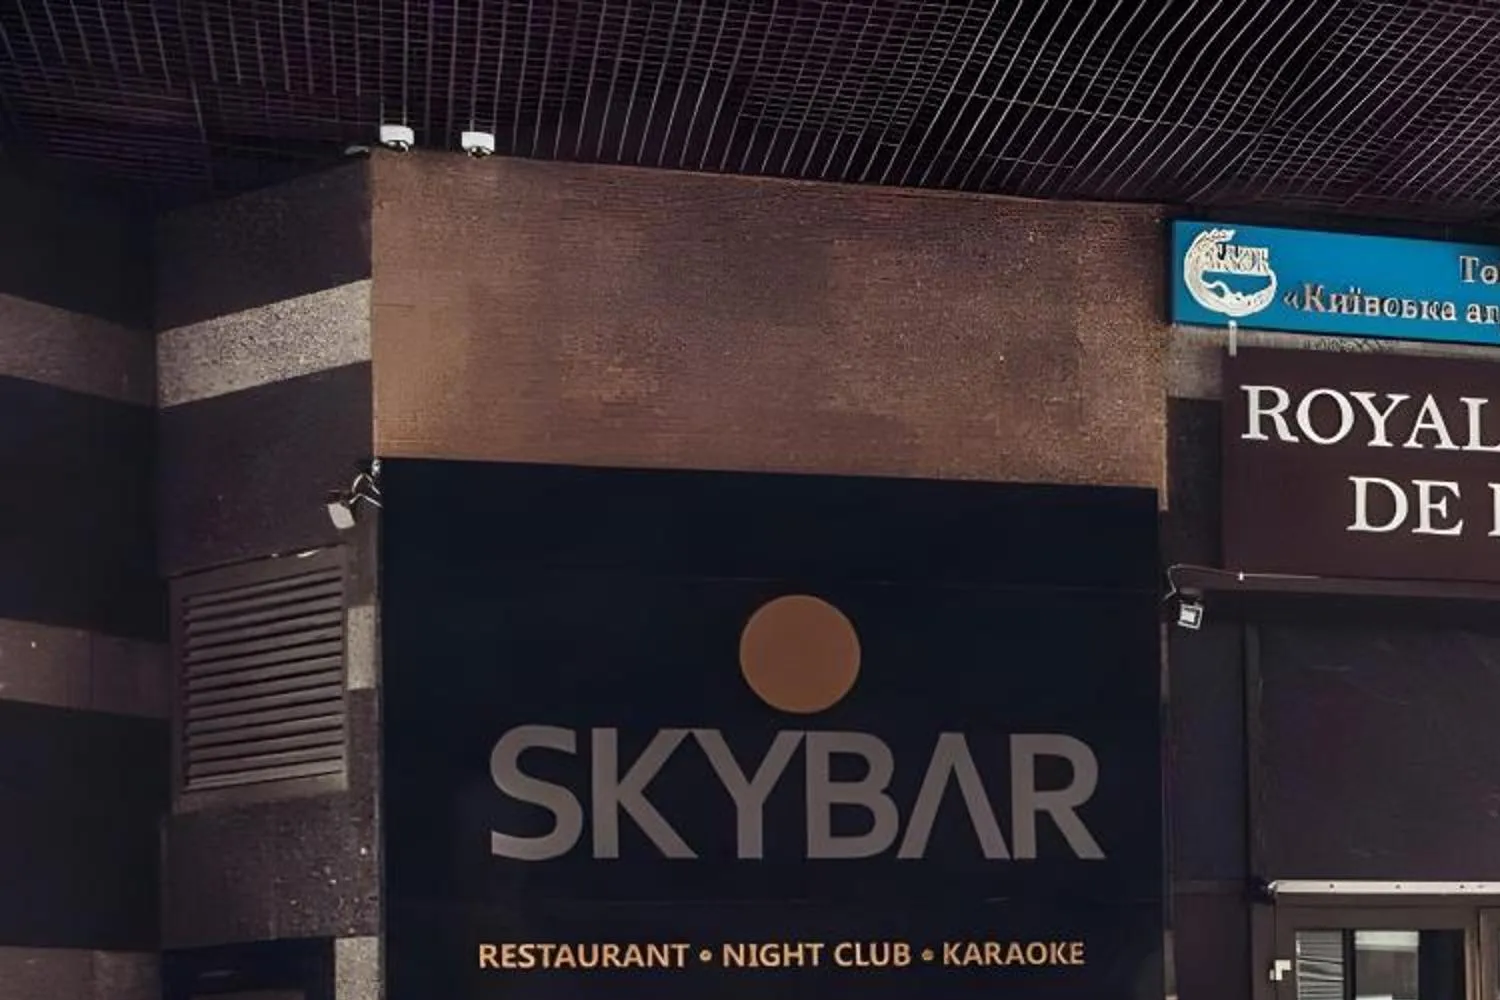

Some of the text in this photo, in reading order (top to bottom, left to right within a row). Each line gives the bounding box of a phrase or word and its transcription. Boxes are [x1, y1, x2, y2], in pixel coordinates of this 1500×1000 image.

[1346, 476, 1464, 536] DE
[489, 724, 1106, 861] SKYBAR
[478, 941, 1086, 969] RESTAURANT NIGHT CLUB KARAOKE
